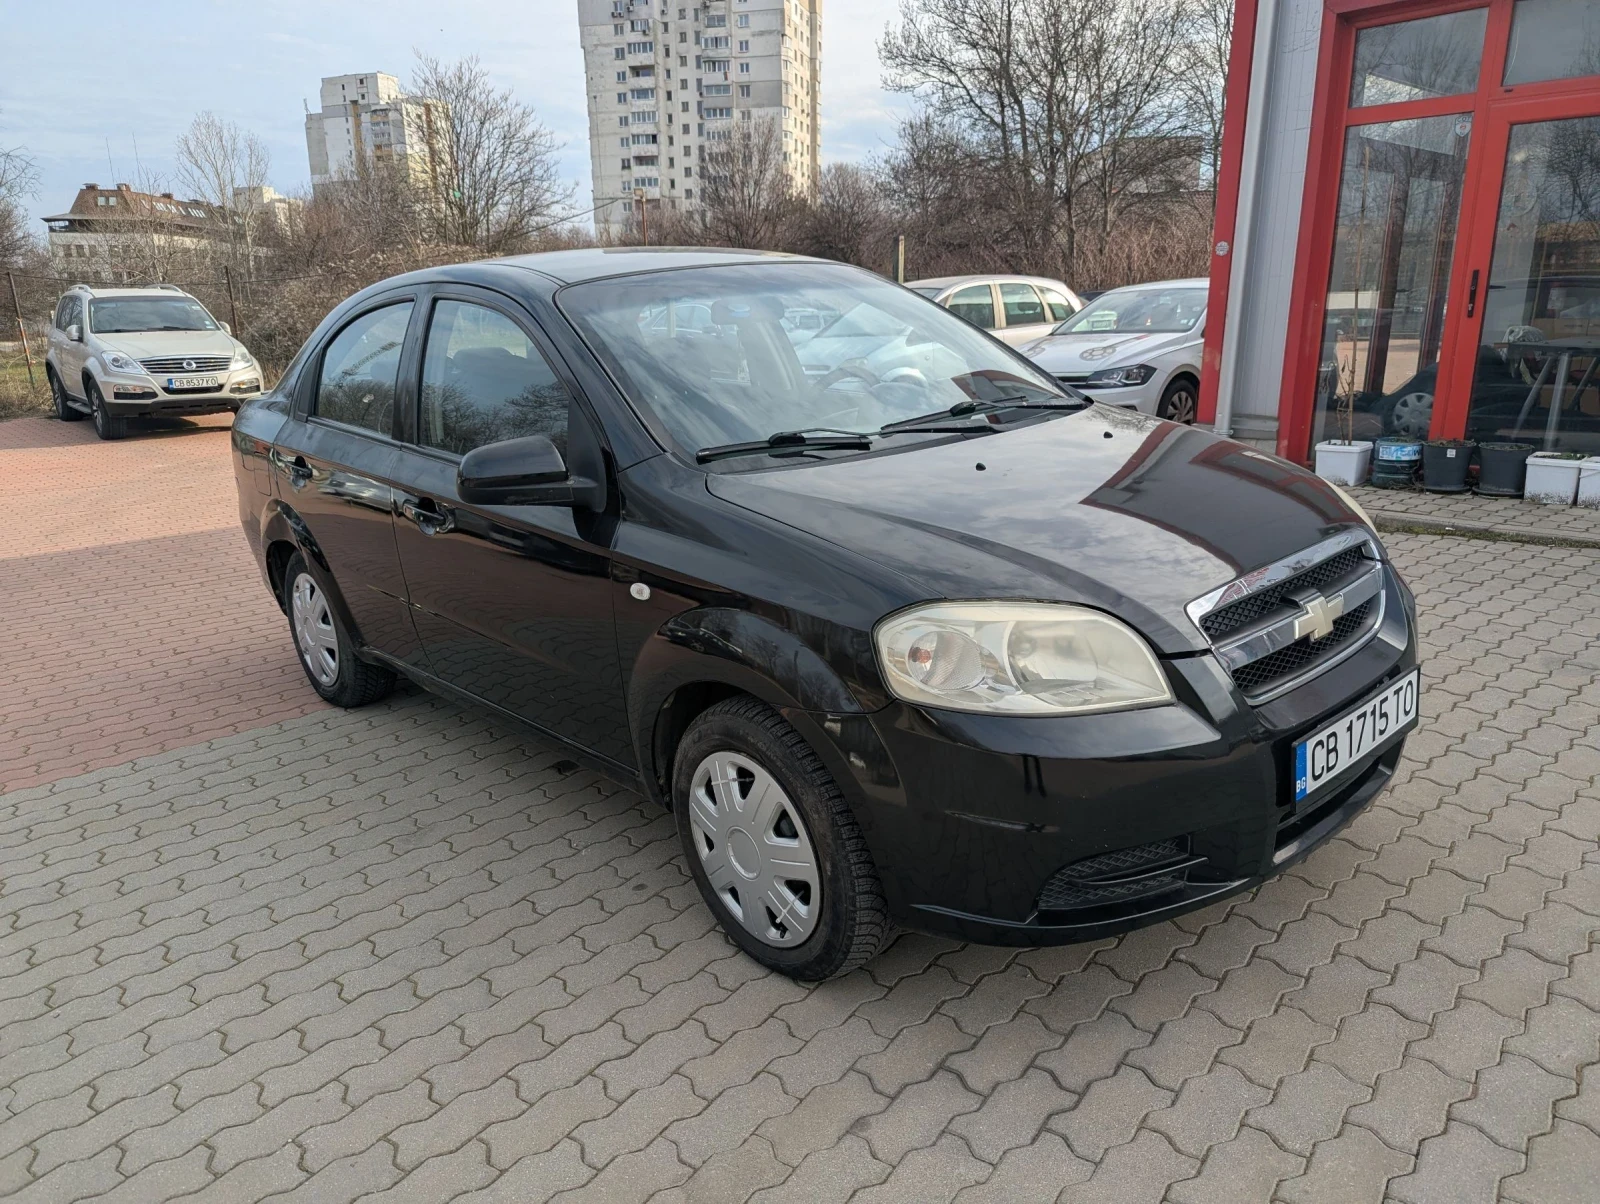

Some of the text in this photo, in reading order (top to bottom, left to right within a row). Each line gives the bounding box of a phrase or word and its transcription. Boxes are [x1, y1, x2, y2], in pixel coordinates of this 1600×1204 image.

[174, 379, 185, 388] CB
[186, 378, 204, 387] 8537
[205, 378, 216, 386] KO
[1311, 679, 1414, 782] CB 1715 TO
[1296, 776, 1306, 793] BG
